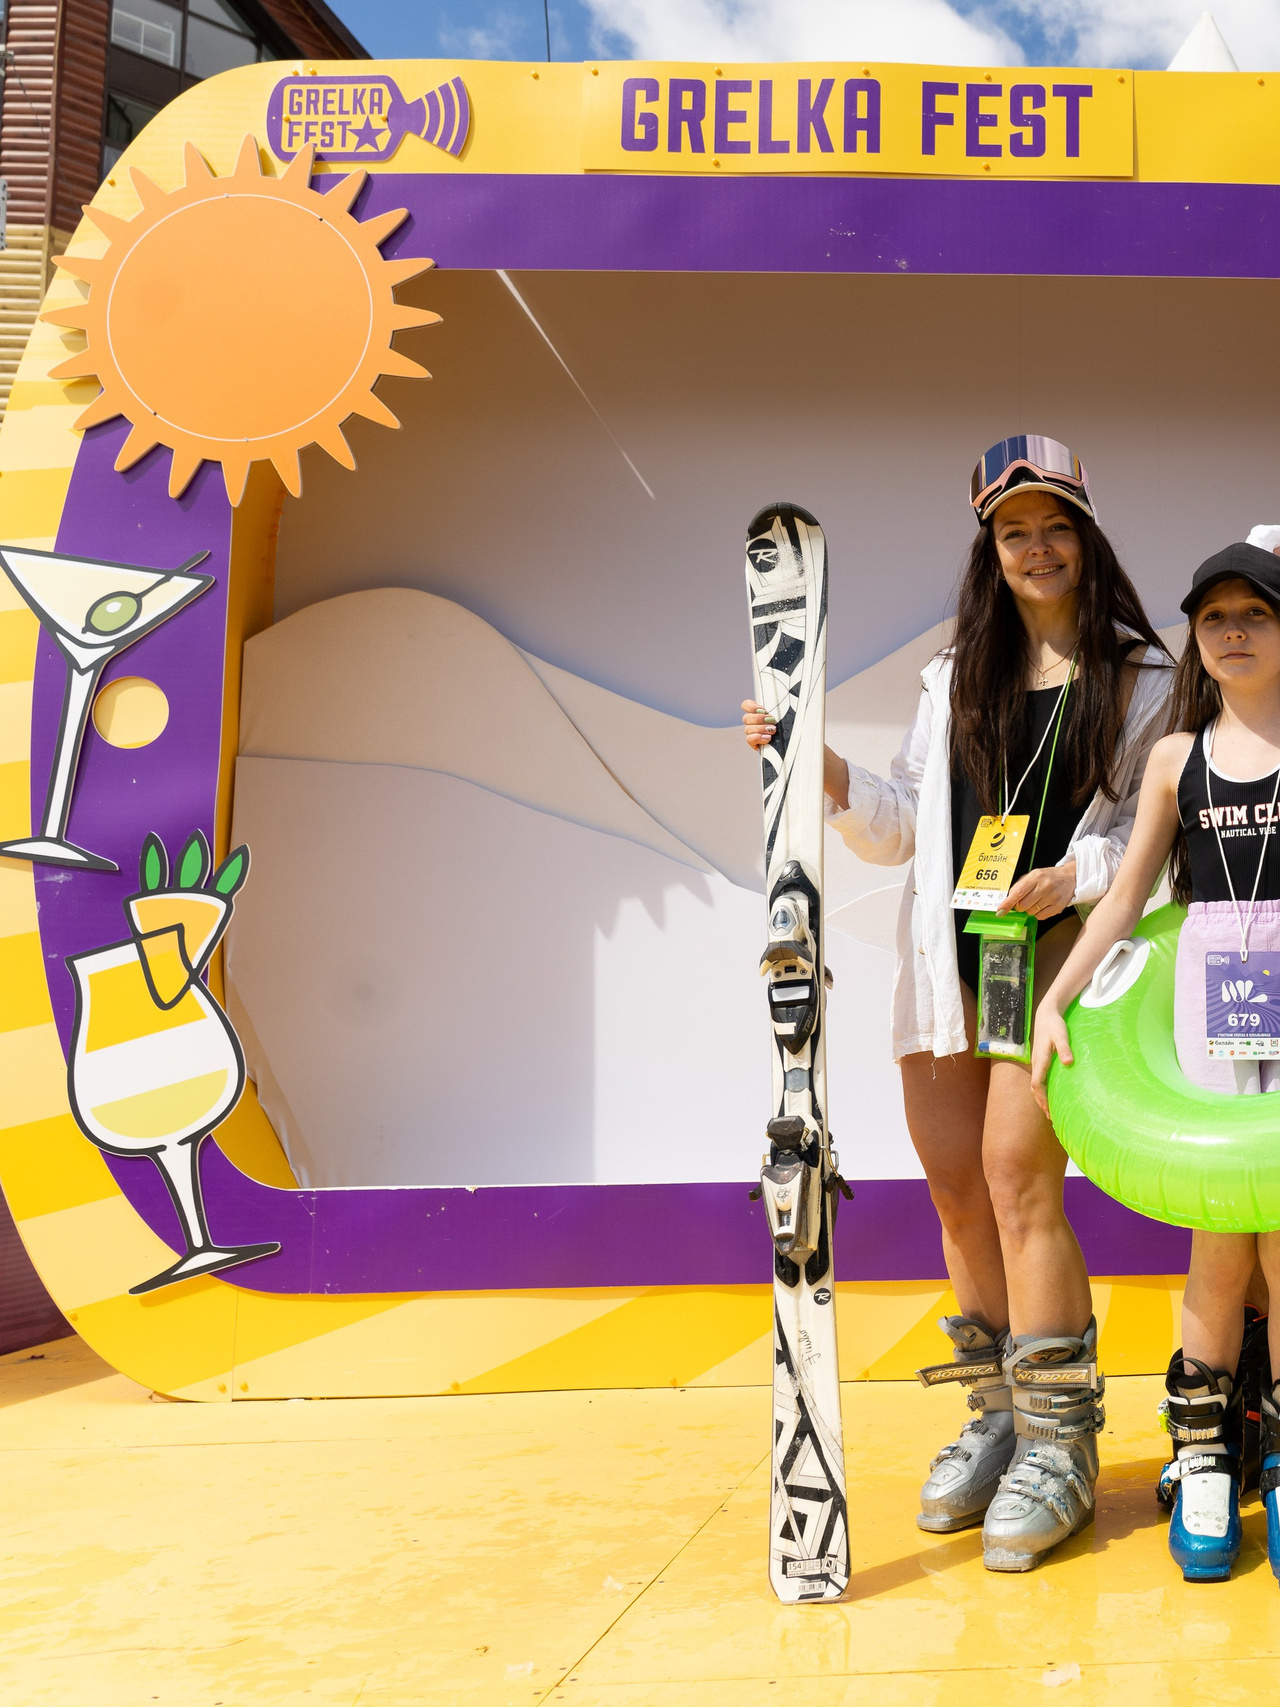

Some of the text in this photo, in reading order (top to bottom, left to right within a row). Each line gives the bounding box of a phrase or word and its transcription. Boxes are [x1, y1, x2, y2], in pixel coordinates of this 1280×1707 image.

[288, 87, 384, 116] GRELKA
[620, 77, 1094, 159] GRELKA FEST
[287, 120, 353, 149] FEST
[1198, 804, 1249, 830] SWIM
[1220, 827, 1257, 839] NAUTICAL
[977, 852, 1008, 863] билайн
[975, 869, 999, 881] 656
[1227, 1013, 1261, 1027] 679
[929, 1365, 996, 1382] NORDICA
[1015, 1369, 1087, 1382] NORDICA
[788, 1562, 802, 1571] 154
